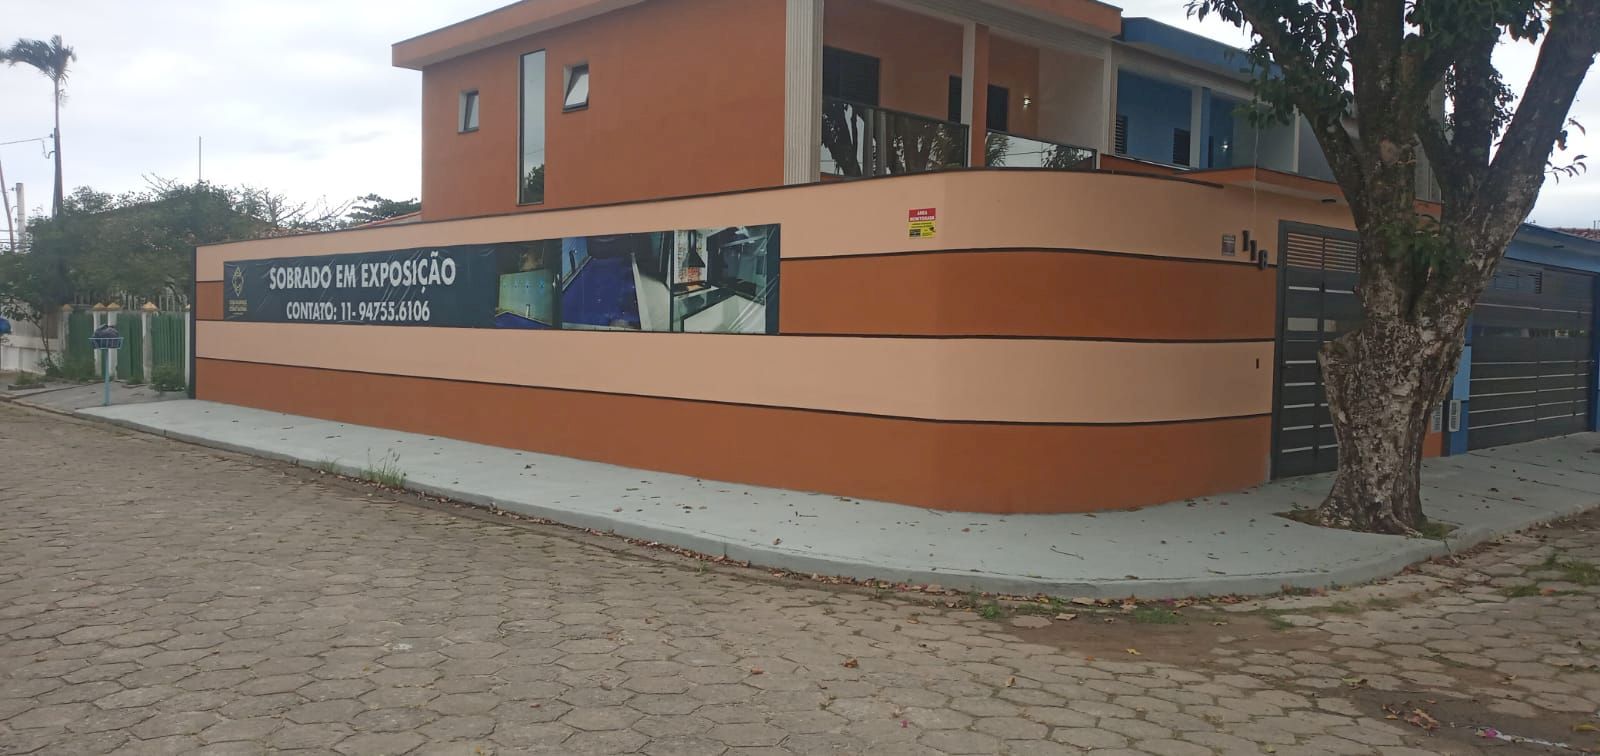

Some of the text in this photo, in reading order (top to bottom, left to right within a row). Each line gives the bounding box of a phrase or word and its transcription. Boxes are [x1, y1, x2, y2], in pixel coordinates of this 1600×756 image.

[269, 251, 456, 293] SOBRADO EM EXPOSIÇÃO
[286, 301, 431, 321] CONTATO: 11- 94755.6106
